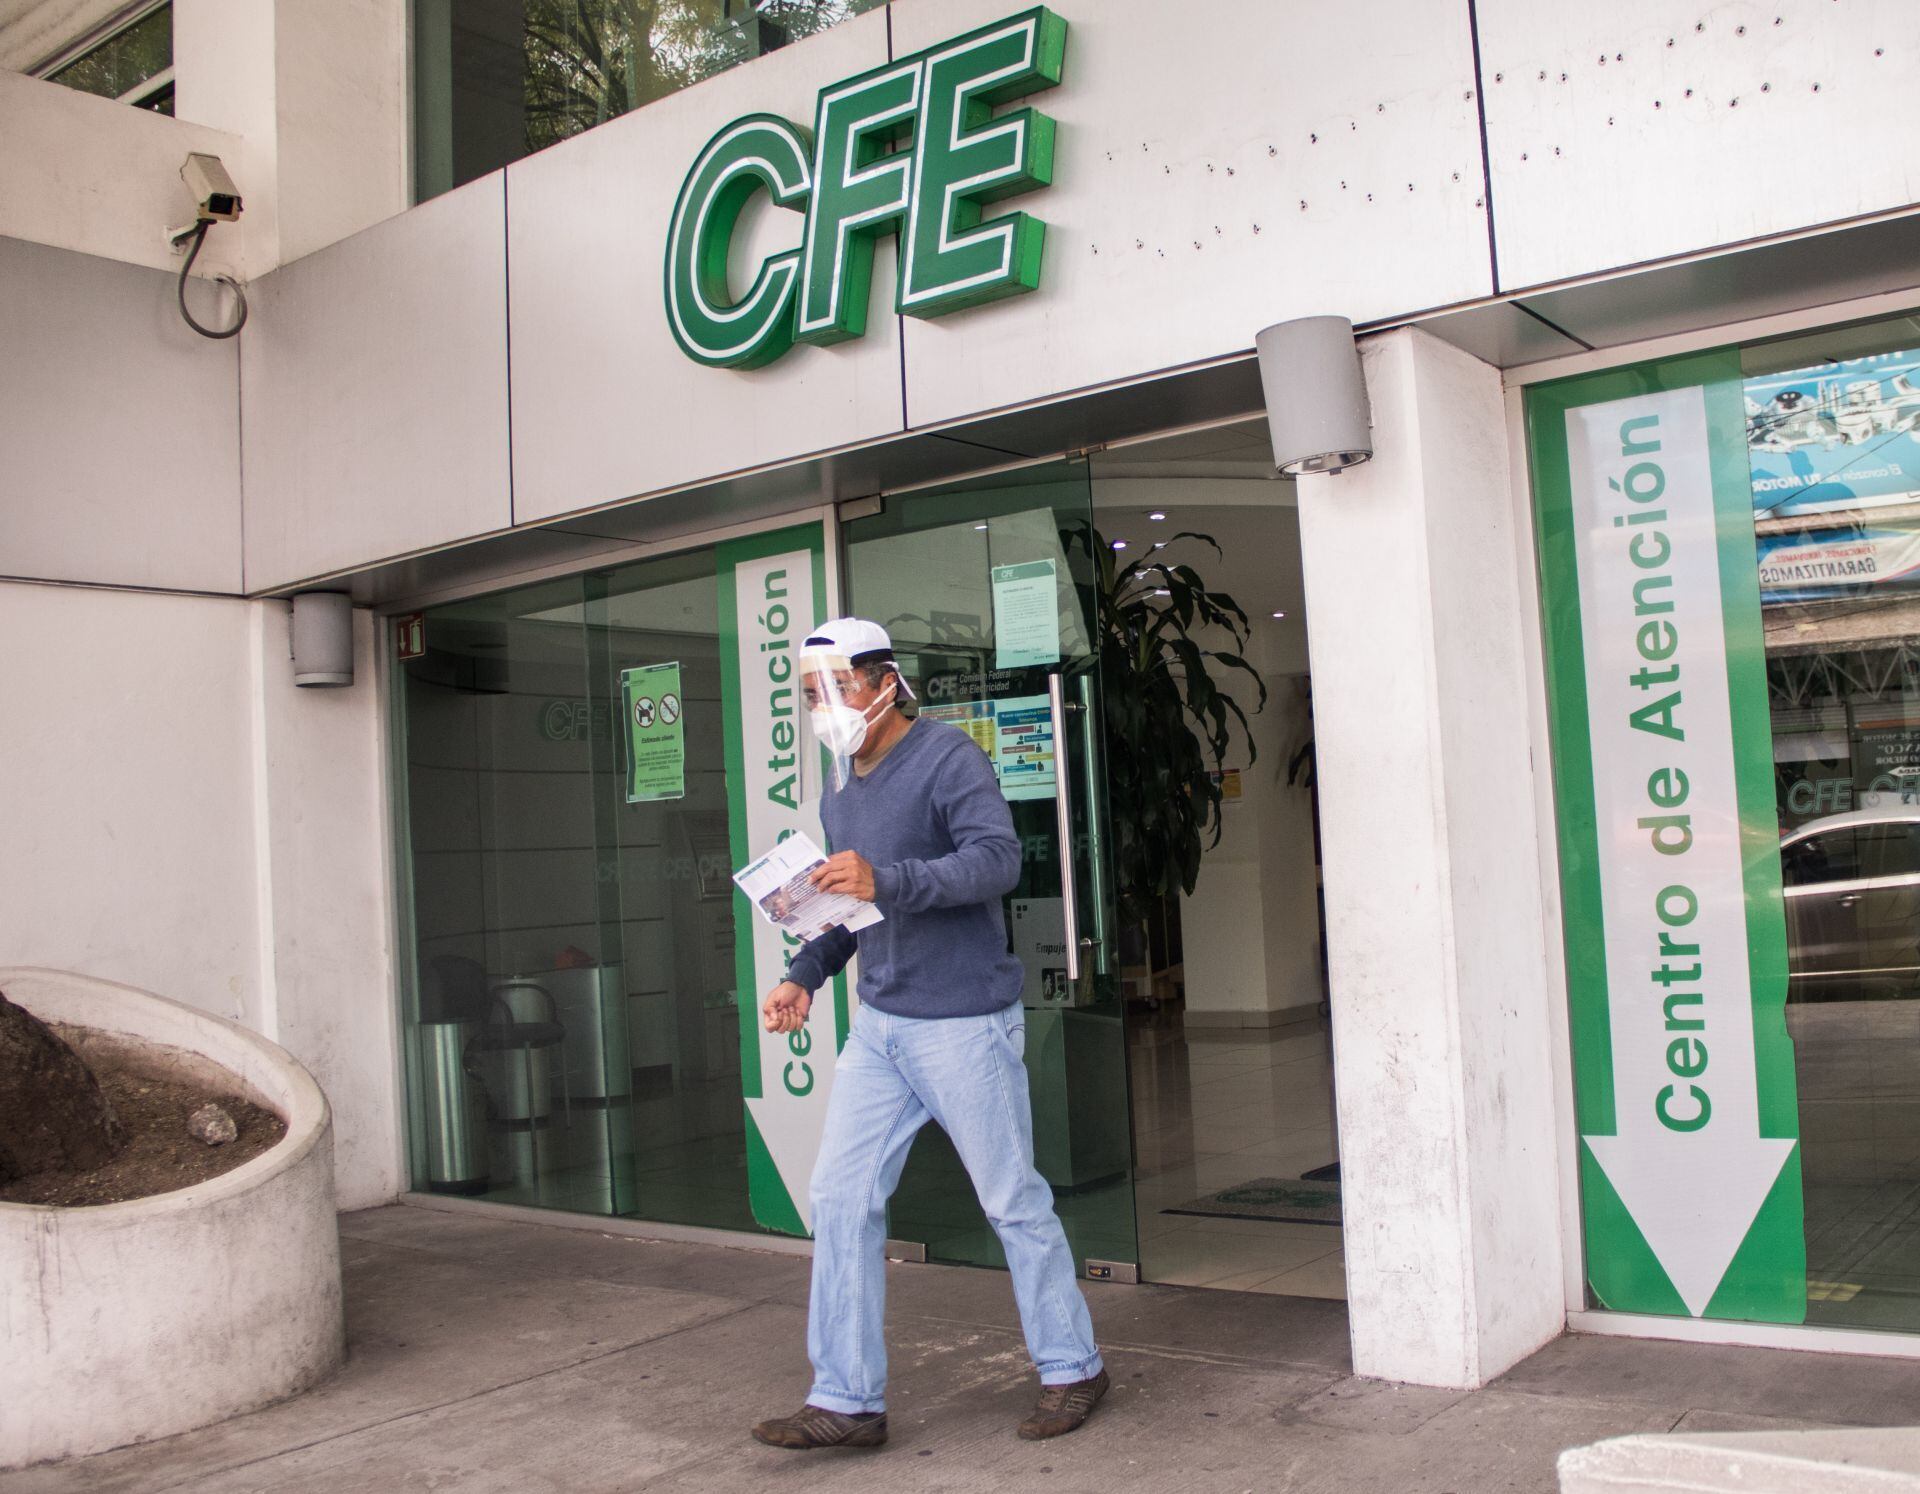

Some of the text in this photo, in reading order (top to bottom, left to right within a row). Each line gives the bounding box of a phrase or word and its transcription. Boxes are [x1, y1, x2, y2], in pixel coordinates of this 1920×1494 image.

[664, 5, 1067, 371] CFE
[758, 569, 798, 810] Atención
[927, 675, 958, 698] CFE
[989, 670, 1011, 681] Federal
[1609, 414, 1712, 1132] Centro de Atención
[1788, 778, 1853, 815] CFE
[1036, 943, 1067, 955] Empuje
